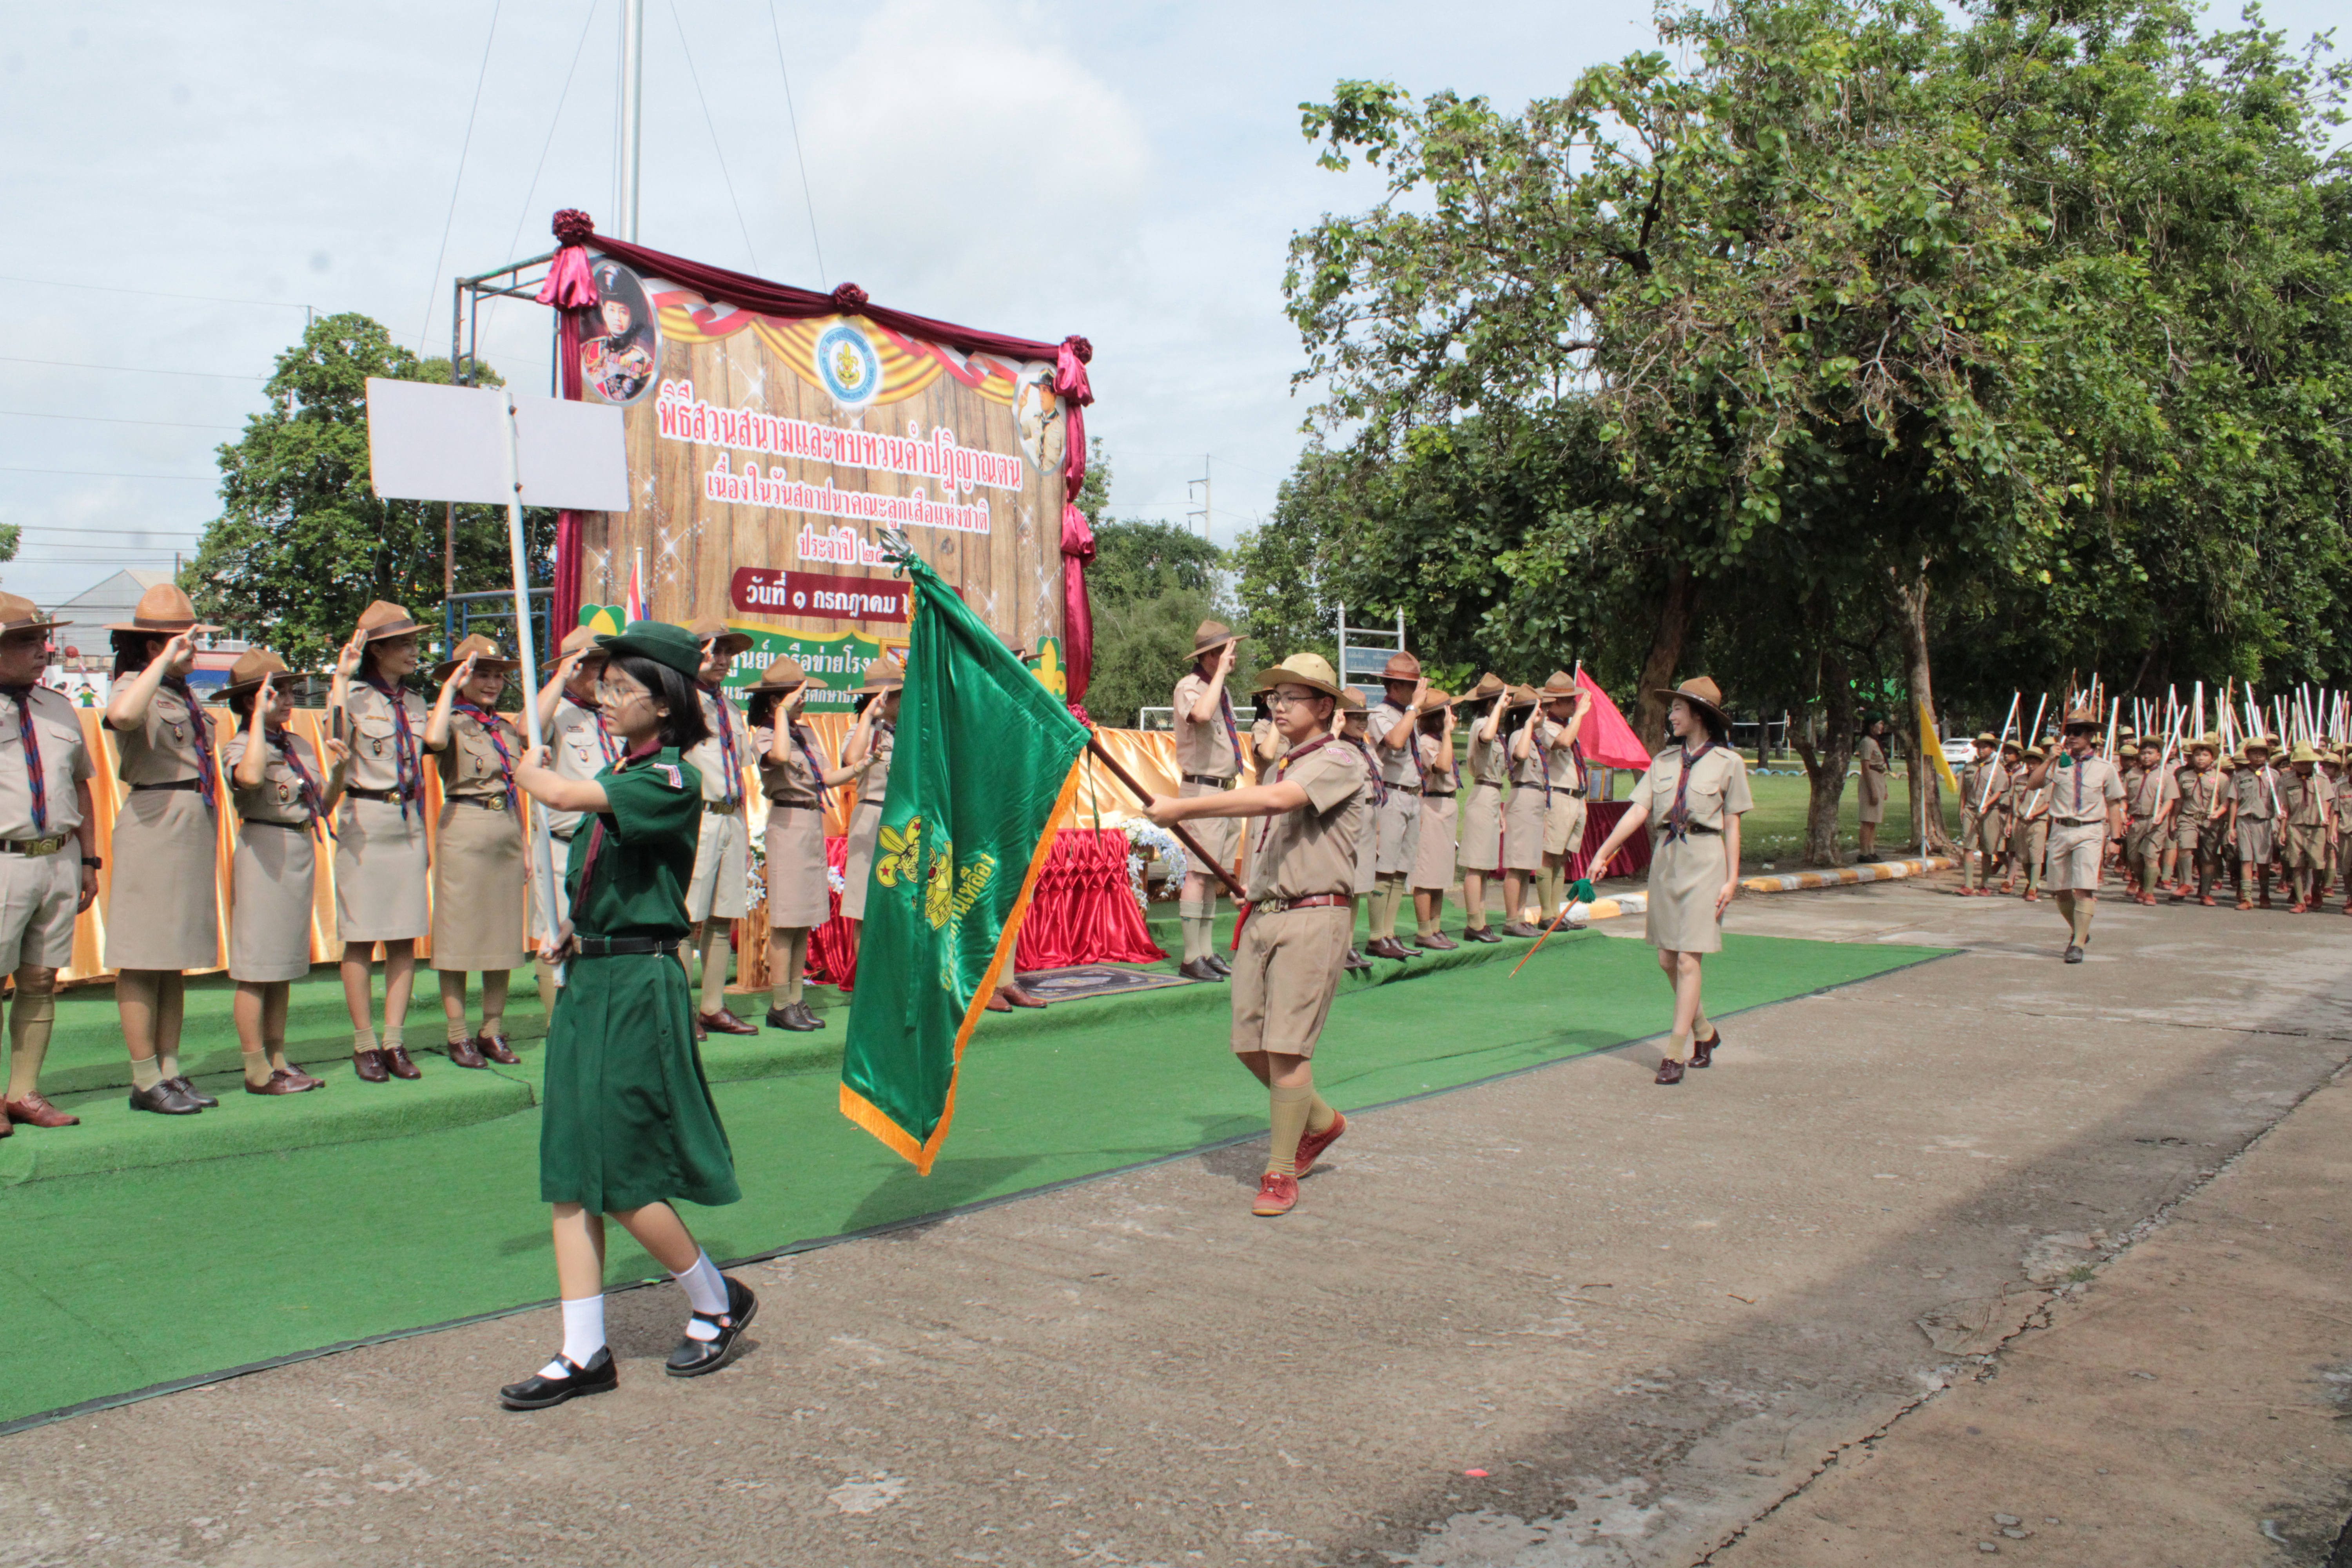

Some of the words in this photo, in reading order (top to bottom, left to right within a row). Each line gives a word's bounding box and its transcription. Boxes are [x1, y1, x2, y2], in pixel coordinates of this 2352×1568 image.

[822, 357, 831, 378] NATIONAL
[829, 378, 839, 392] SCOUT
[838, 390, 863, 399] ORGANIZATION
[866, 367, 874, 388] THAILAND
[659, 383, 1021, 490] พิธีสวนสนามและทบทวนคำปฏิญาณตน
[708, 456, 987, 530] เนื่องในวันสถาปนาคณะลูกเสือแห่งชาติ
[800, 527, 854, 561] ประจำปี
[746, 571, 786, 605] วันที่
[793, 591, 806, 609] ๑
[813, 590, 897, 617] กรกฎาคม
